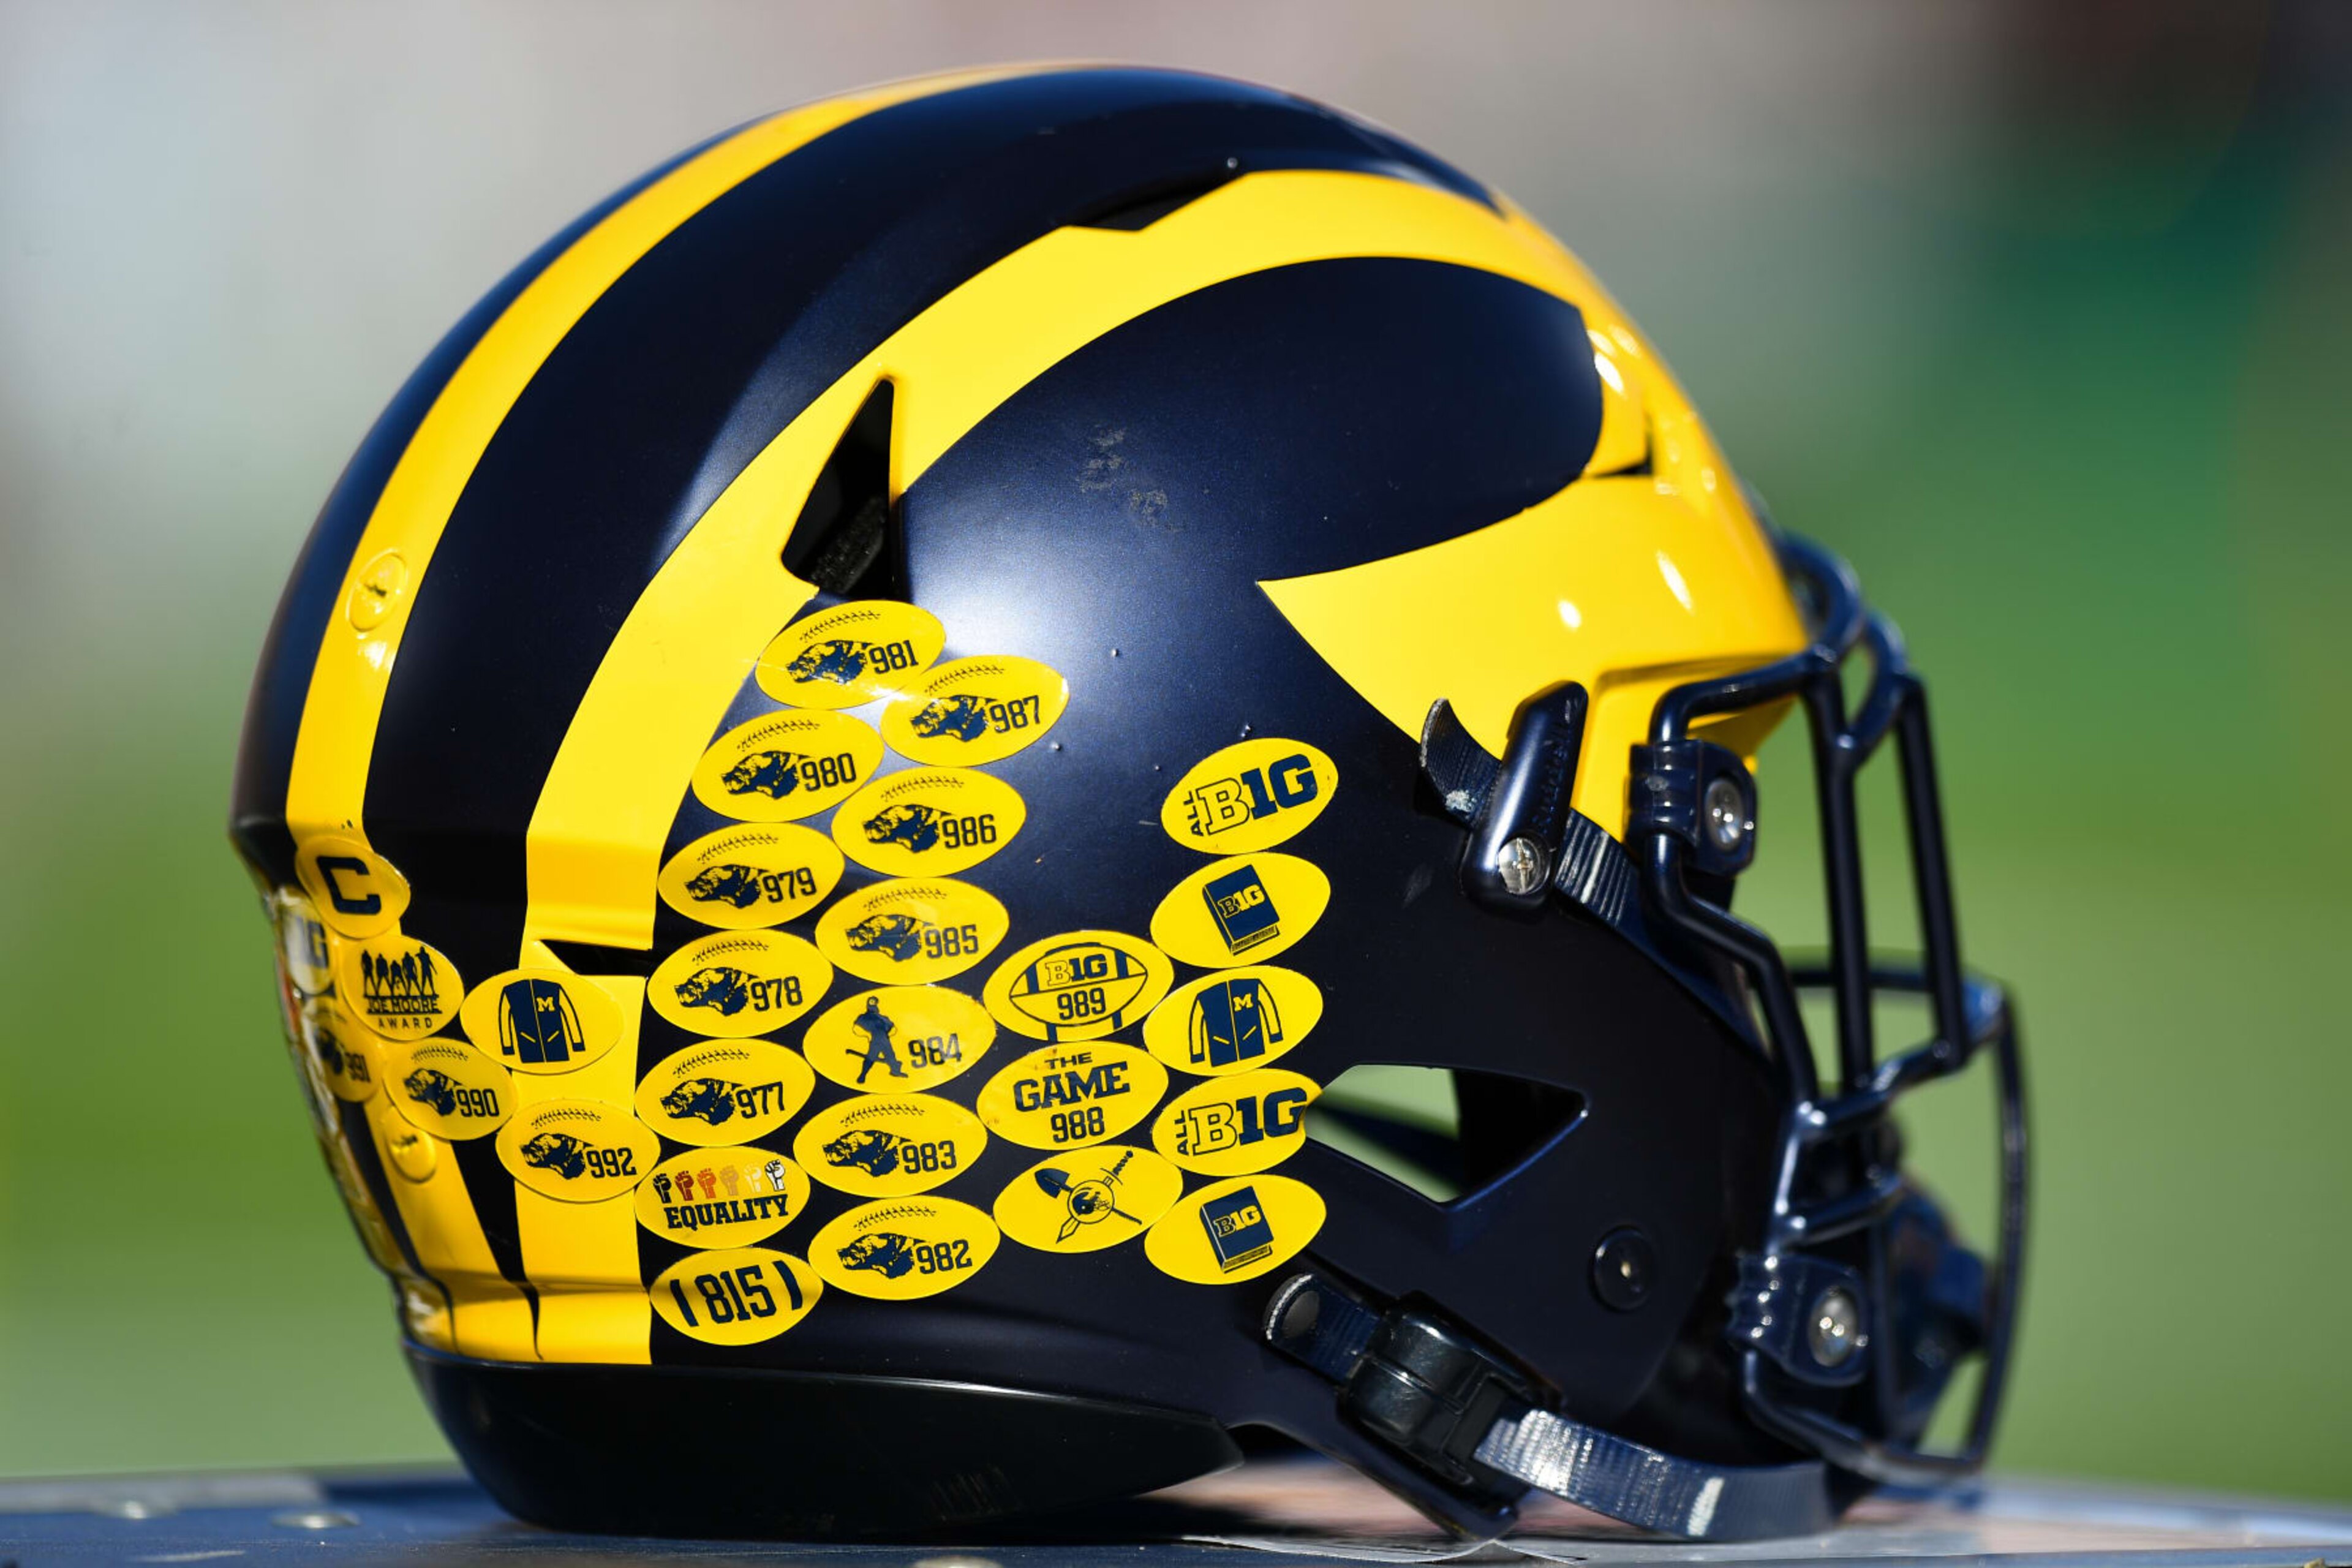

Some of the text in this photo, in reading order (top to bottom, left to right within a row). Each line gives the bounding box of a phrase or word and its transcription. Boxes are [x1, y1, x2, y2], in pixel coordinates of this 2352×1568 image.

[869, 641, 918, 673] 981
[990, 696, 1039, 732] 987
[802, 753, 856, 791] 980
[1183, 790, 1204, 836] ALL
[943, 815, 996, 848] 986
[316, 856, 382, 914] C
[766, 868, 816, 902] 979
[926, 925, 978, 957] 985
[368, 997, 439, 1012] JOE MOORE
[537, 997, 554, 1011] M
[752, 977, 802, 1011] 978
[1057, 988, 1106, 1020] 989
[1234, 993, 1253, 1011] M
[379, 1017, 432, 1028] AWARD
[909, 1034, 961, 1067] 984
[1045, 1054, 1092, 1068] THE
[458, 1089, 499, 1117] 990
[736, 1082, 785, 1118] 977
[1014, 1062, 1129, 1112] GAME
[1051, 1107, 1105, 1142] 988
[1174, 1110, 1189, 1155] ALL
[586, 1148, 636, 1178] 992
[902, 1141, 956, 1174] 983
[665, 1194, 788, 1229] EQUALITY
[918, 1240, 972, 1275] 982
[695, 1265, 775, 1324] 815
